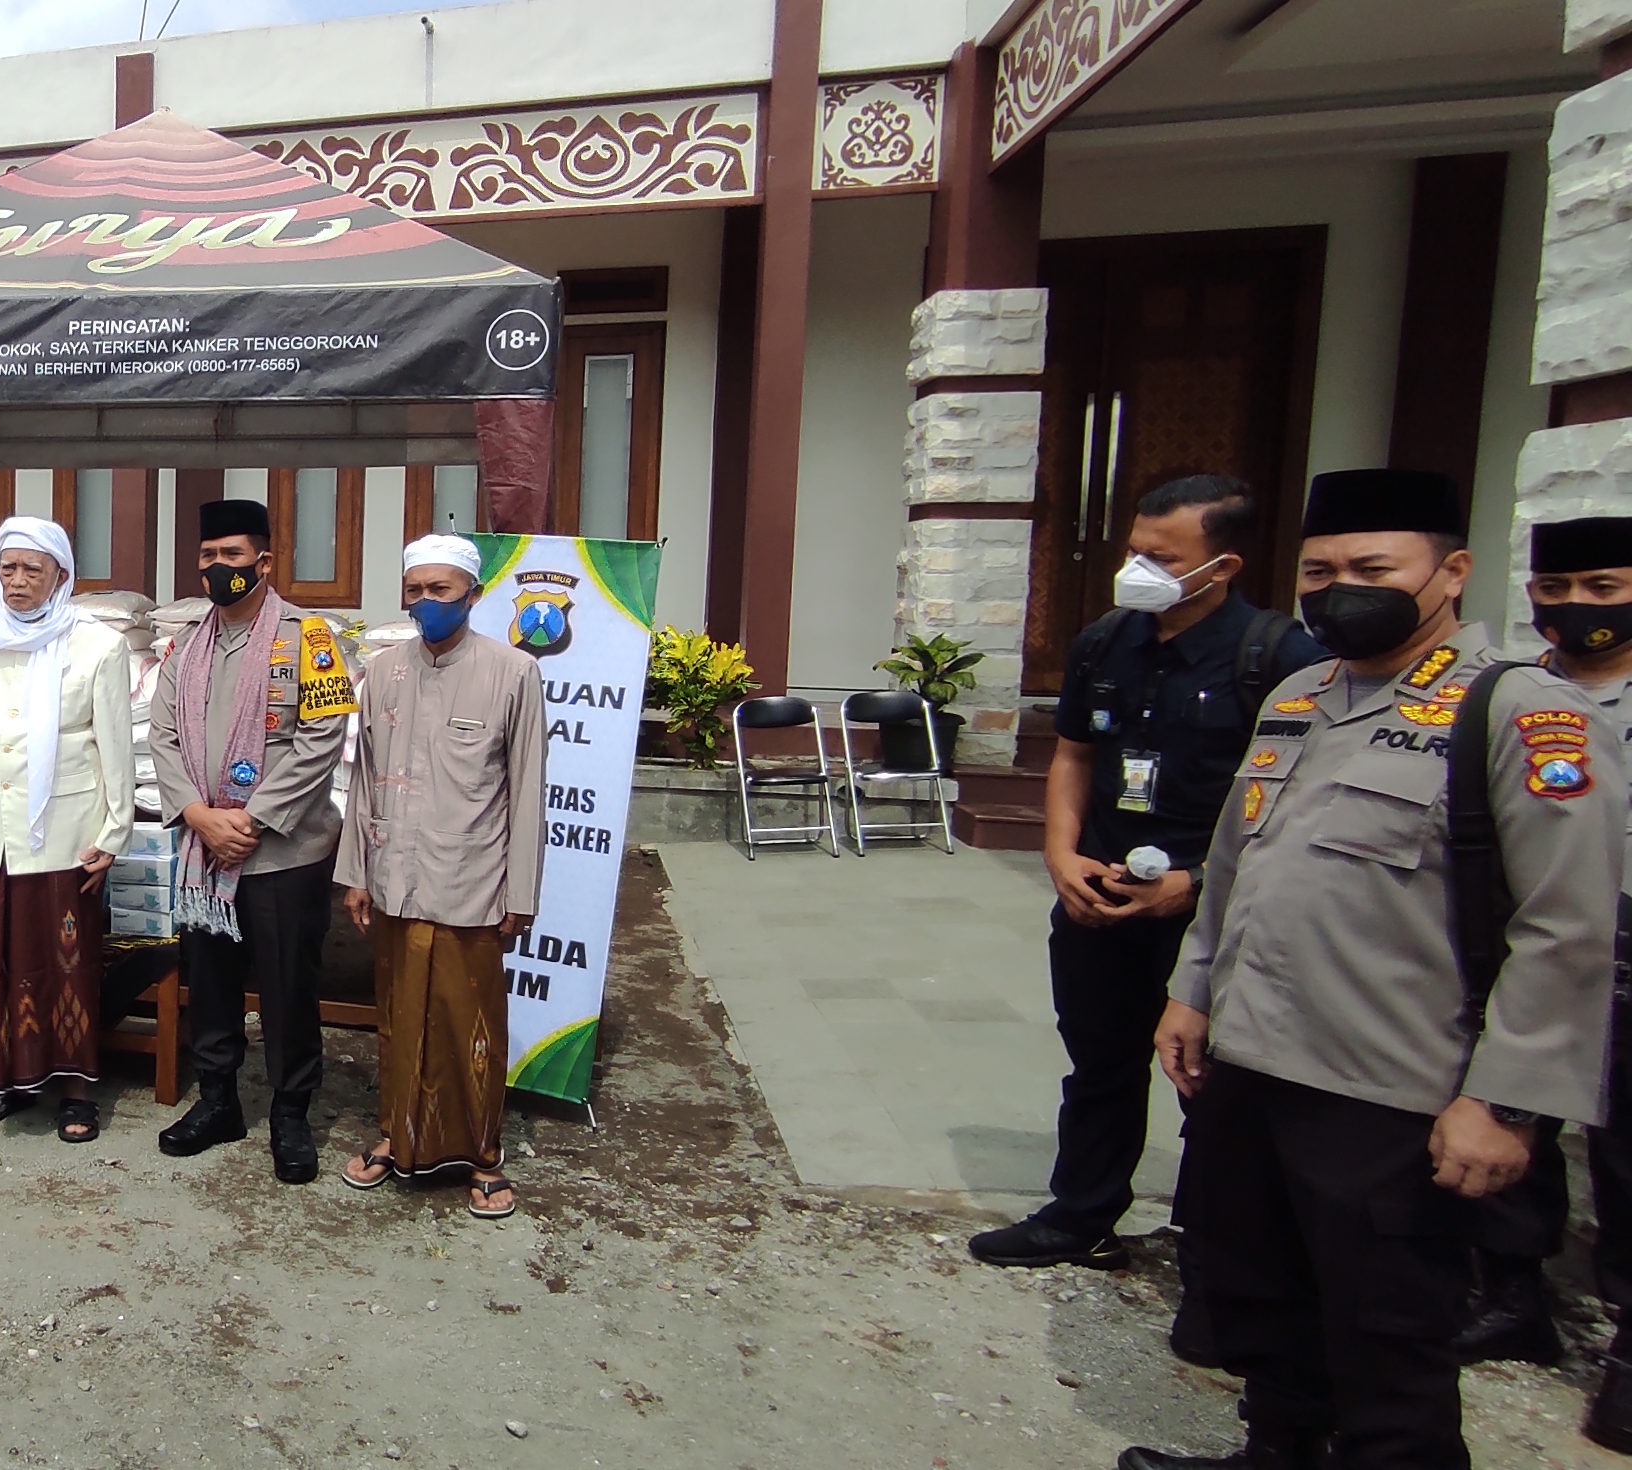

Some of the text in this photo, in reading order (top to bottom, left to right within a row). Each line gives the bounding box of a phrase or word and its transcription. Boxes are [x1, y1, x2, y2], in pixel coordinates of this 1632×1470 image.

[68, 318, 190, 336] PERINGATAN:
[49, 341, 90, 355] SAYA
[92, 339, 168, 355] TERKENA
[172, 337, 240, 352] KANKER
[243, 335, 379, 351] TENGGOROKAN
[496, 329, 541, 349] 18+
[34, 362, 107, 376] BERHENTI
[110, 360, 185, 375] MEROKOK
[187, 357, 301, 375] (0800-177-6565)
[546, 573, 573, 586] TIMUR
[306, 697, 355, 711] SEMERU
[1519, 711, 1583, 727] POLDA
